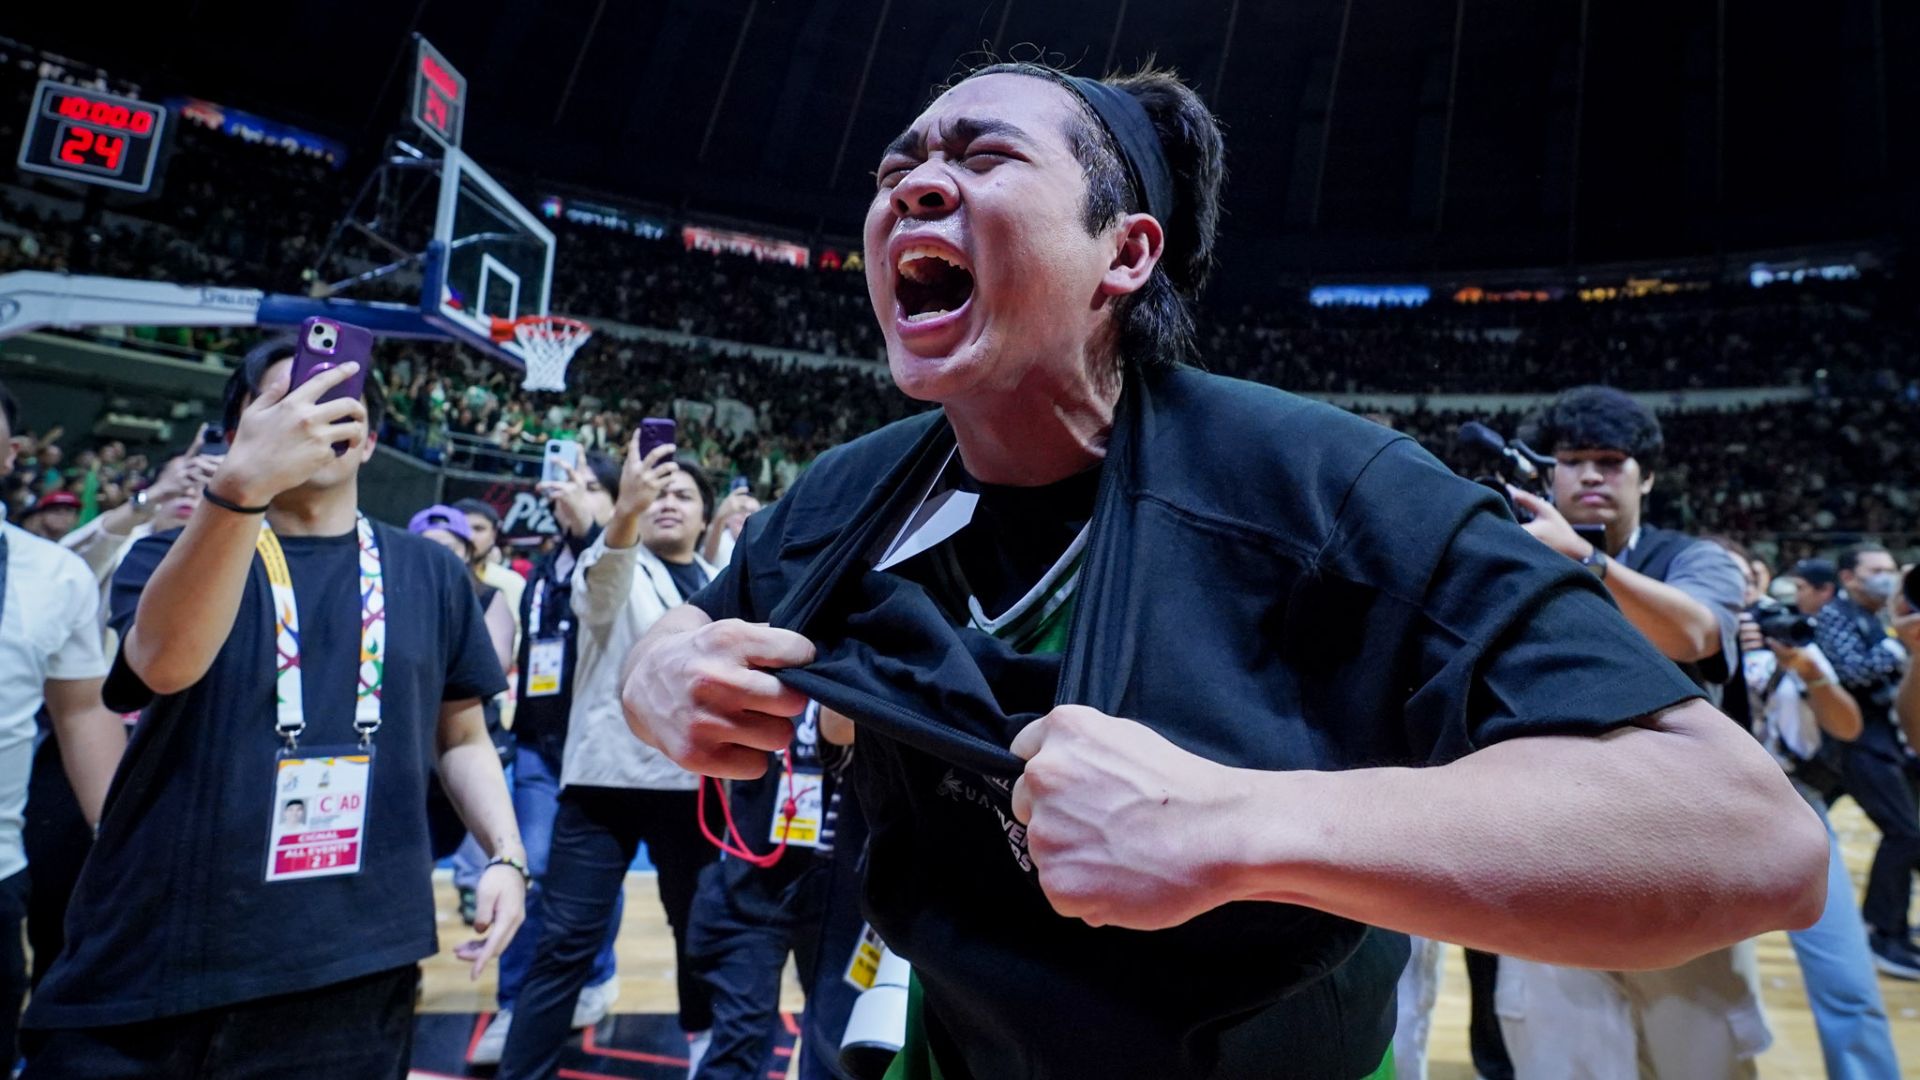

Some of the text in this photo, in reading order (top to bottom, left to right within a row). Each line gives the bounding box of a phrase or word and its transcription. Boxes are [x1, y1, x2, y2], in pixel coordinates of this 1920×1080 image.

[61, 127, 123, 169] 24
[320, 795, 360, 812] C AD
[284, 843, 350, 859] ALL EVENTS
[312, 853, 337, 868] 2 3
